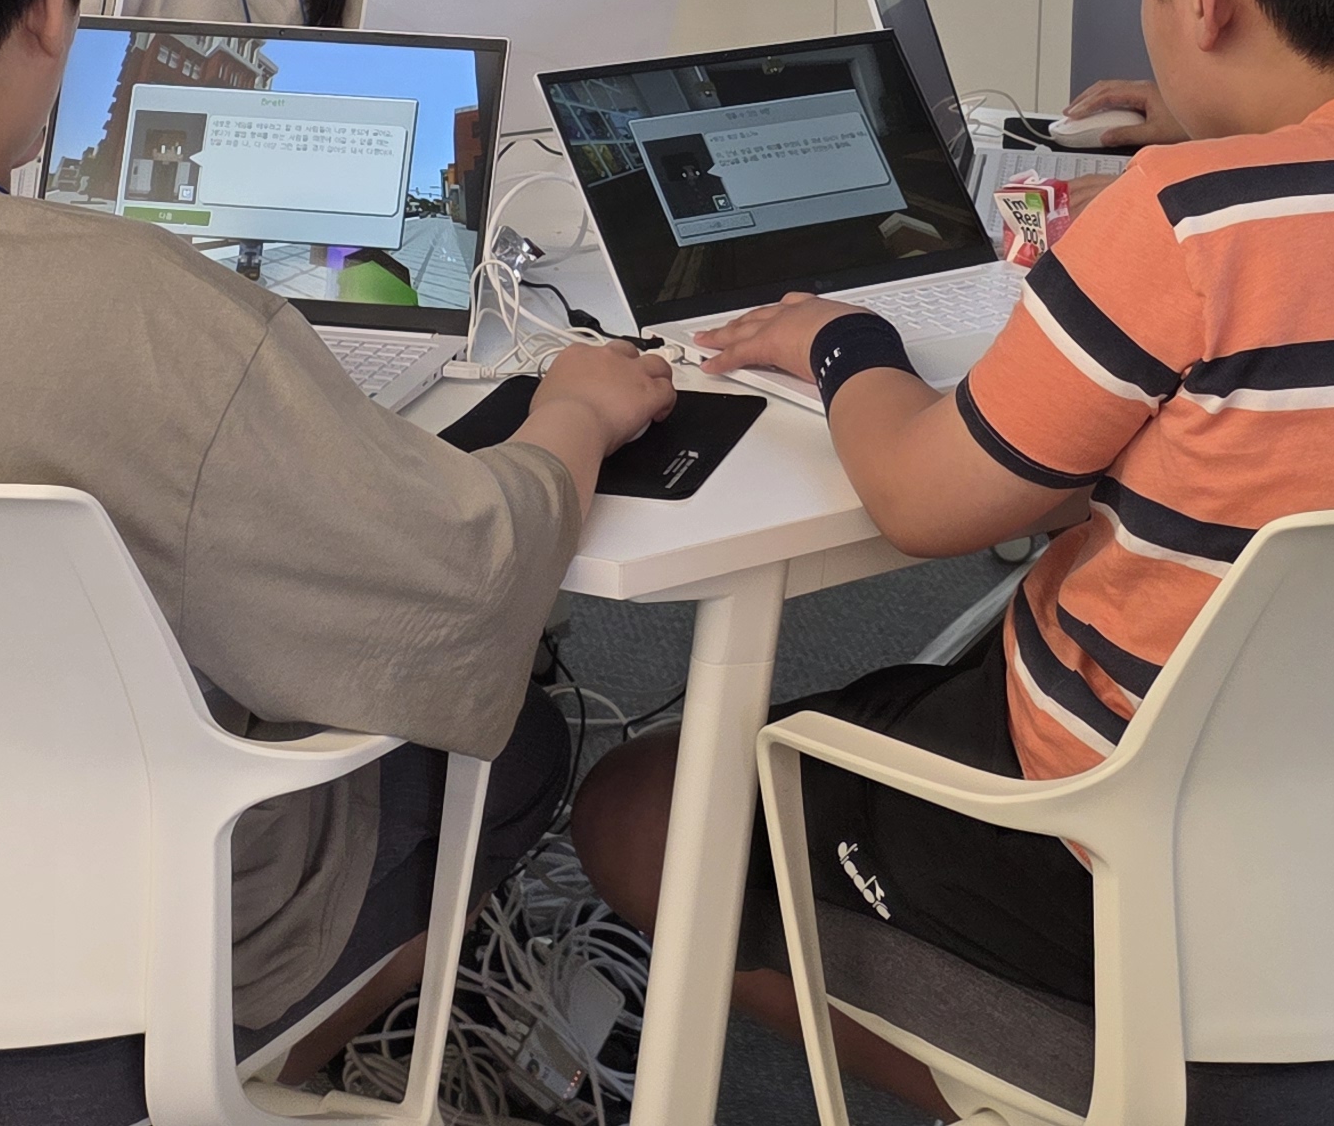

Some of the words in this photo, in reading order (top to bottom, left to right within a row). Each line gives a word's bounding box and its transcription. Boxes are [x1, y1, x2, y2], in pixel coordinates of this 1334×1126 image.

[1002, 198, 1028, 212] I'm
[1012, 211, 1042, 229] Real
[1020, 226, 1039, 245] 100
